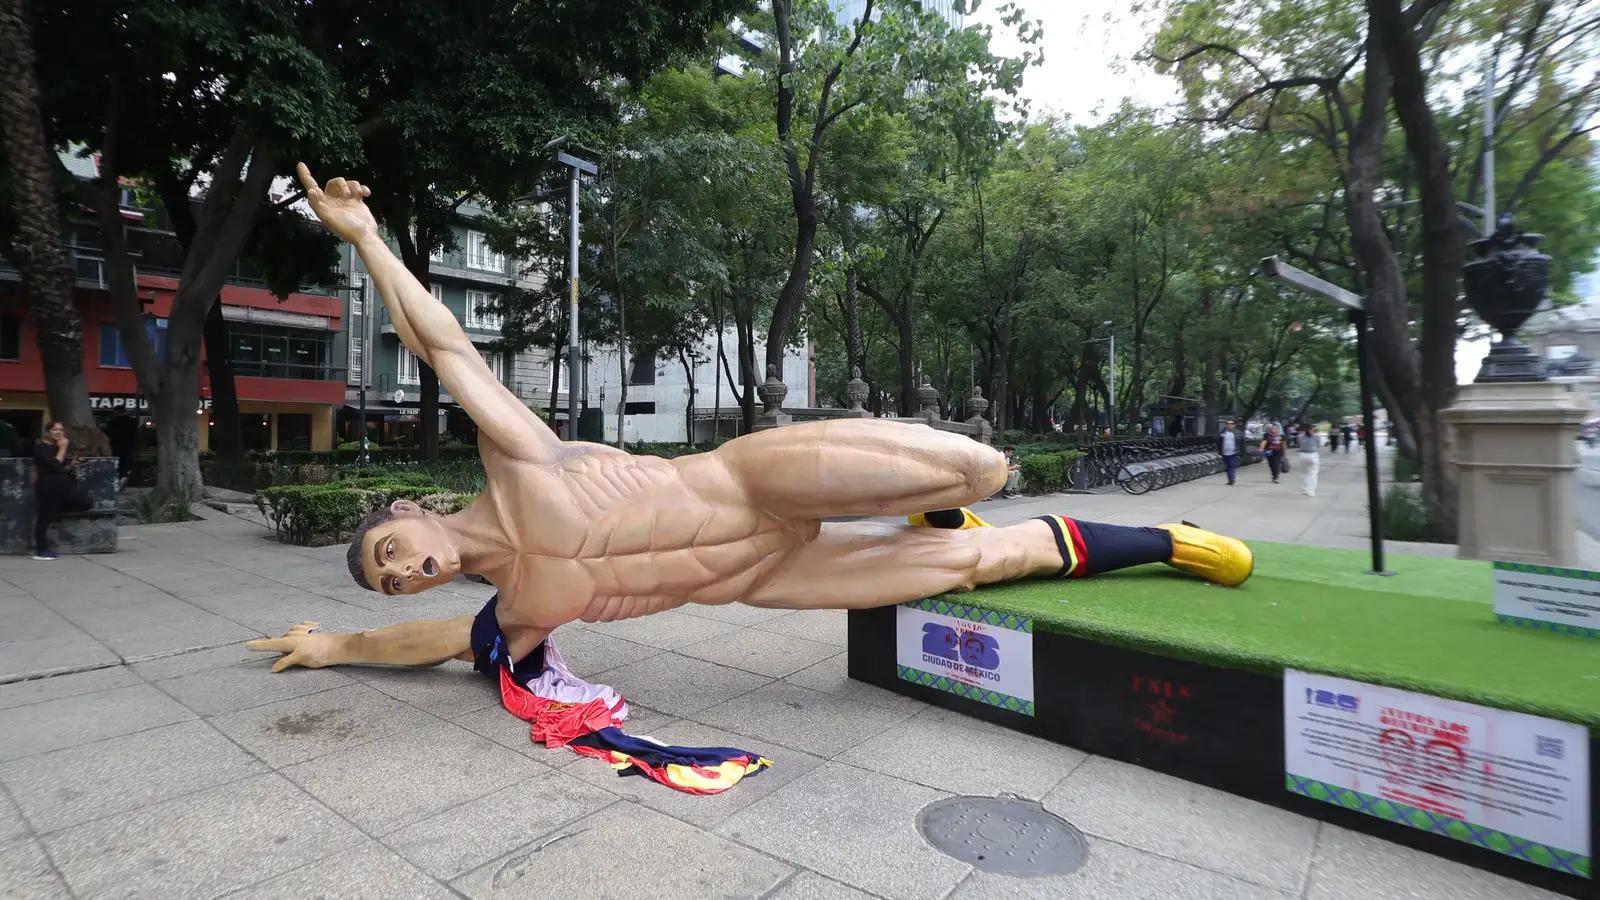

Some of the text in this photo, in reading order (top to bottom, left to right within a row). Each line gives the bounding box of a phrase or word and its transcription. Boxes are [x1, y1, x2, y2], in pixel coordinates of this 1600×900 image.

[89, 397, 149, 409] TARBU
[922, 653, 952, 669] CIUDAD
[952, 662, 964, 672] DE
[965, 665, 1000, 682] MÉXICO
